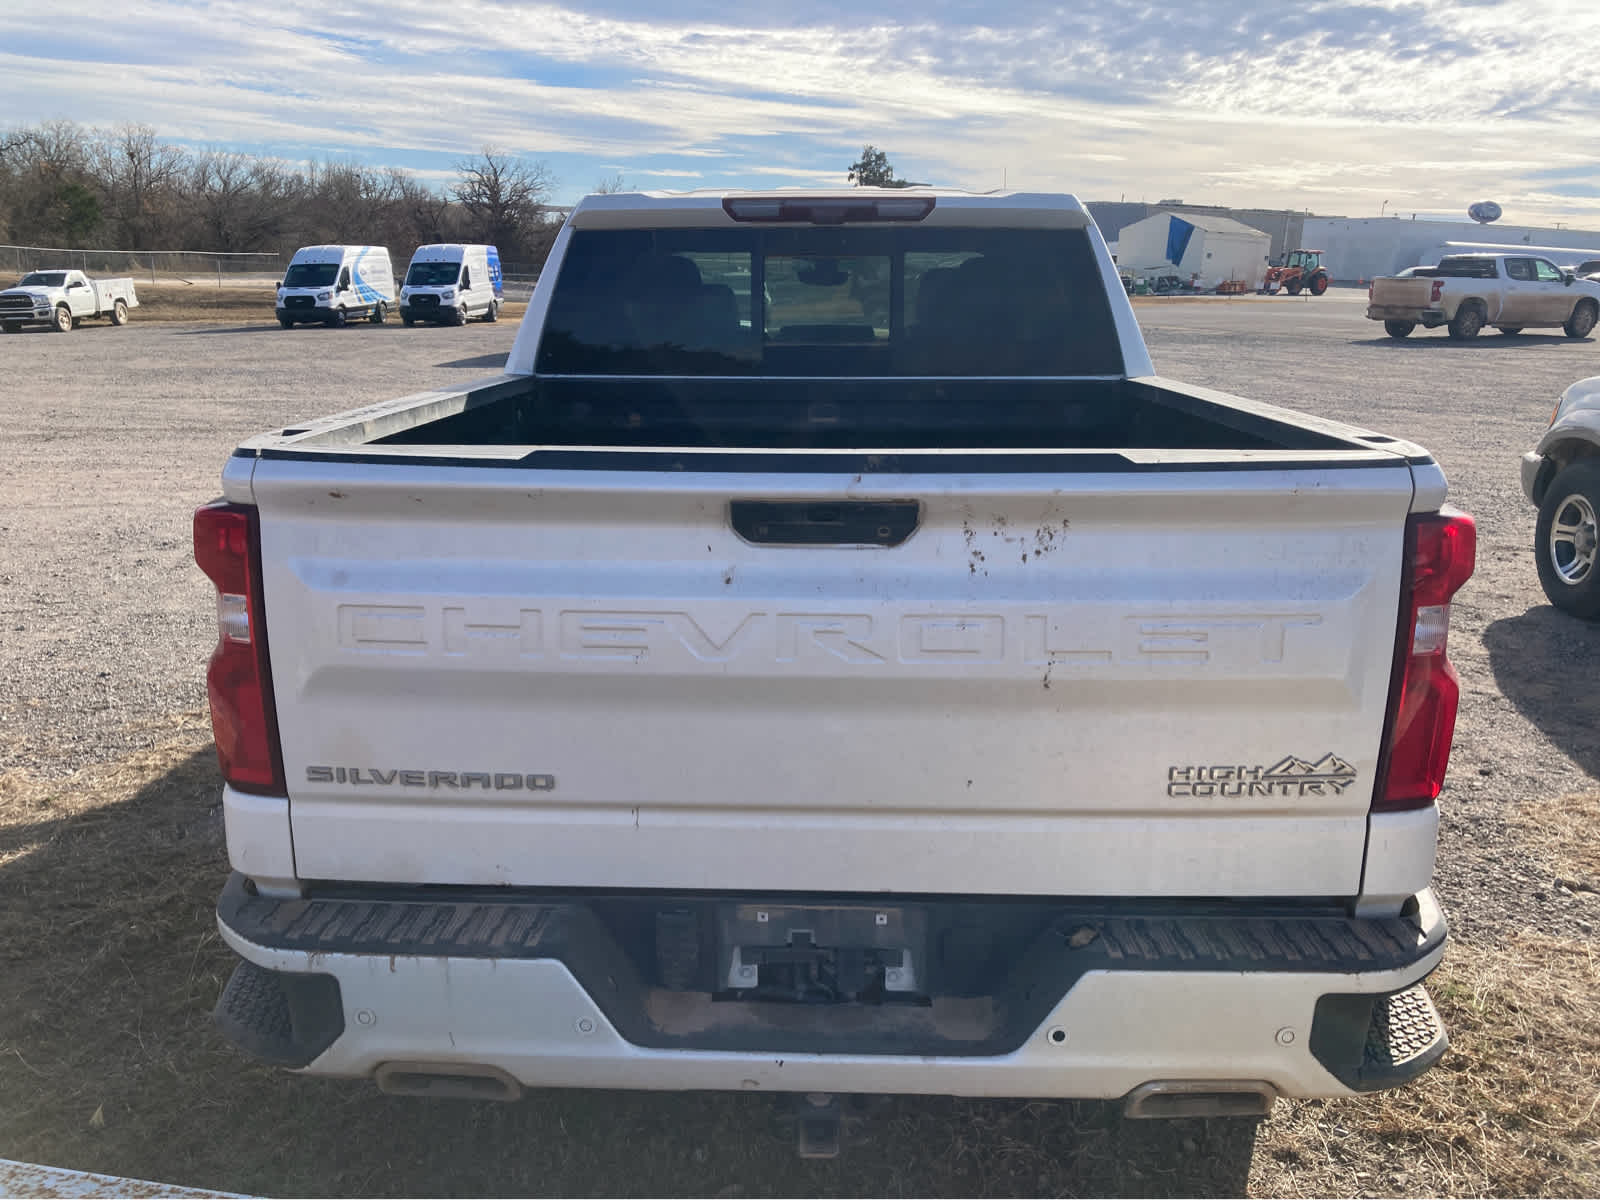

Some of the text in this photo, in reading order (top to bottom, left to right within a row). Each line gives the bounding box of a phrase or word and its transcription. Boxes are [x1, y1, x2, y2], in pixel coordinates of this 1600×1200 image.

[337, 604, 1323, 665] CHEVROLET
[306, 766, 556, 792] SILVERADO
[1168, 766, 1263, 781] HIGH
[1167, 781, 1354, 798] COUNTRY
